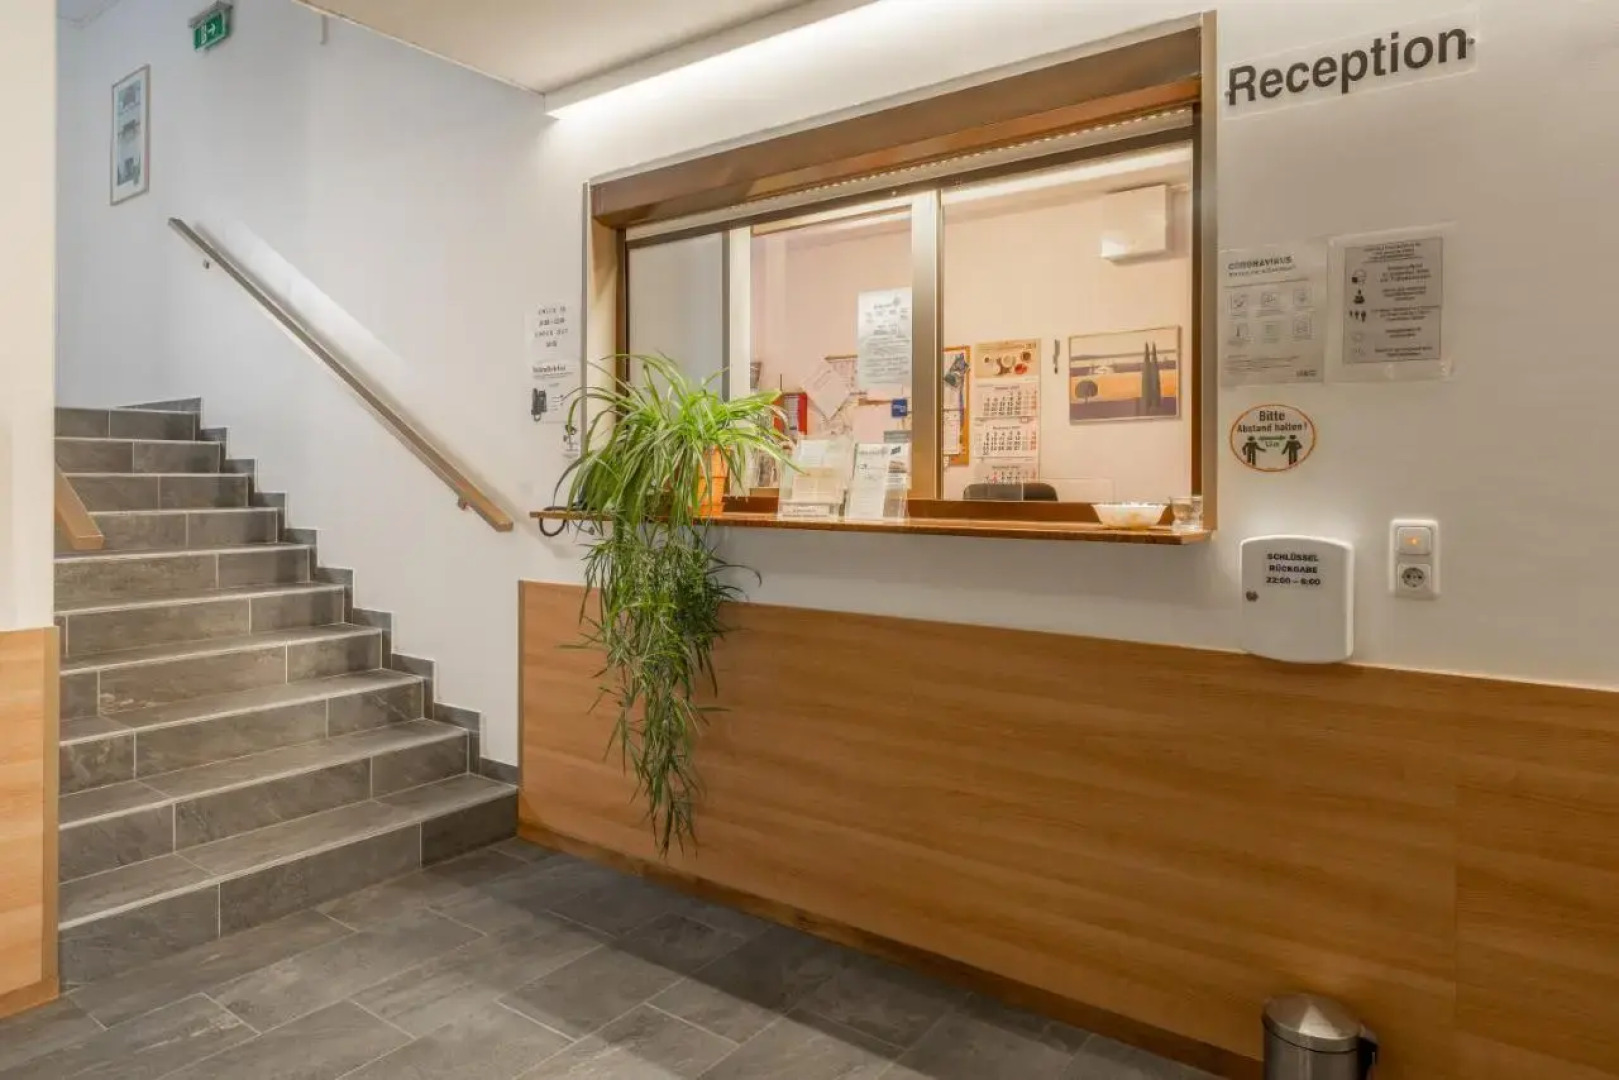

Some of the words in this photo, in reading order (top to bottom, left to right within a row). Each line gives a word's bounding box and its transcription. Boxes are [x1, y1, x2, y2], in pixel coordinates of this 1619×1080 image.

[1228, 27, 1468, 106] Reception
[1259, 410, 1286, 422] Bitte
[1237, 423, 1272, 434] Abstand
[1266, 552, 1319, 562] SCHLÜSSEL
[1268, 563, 1318, 574] RÜCKGABE
[1266, 576, 1290, 584] 22:00
